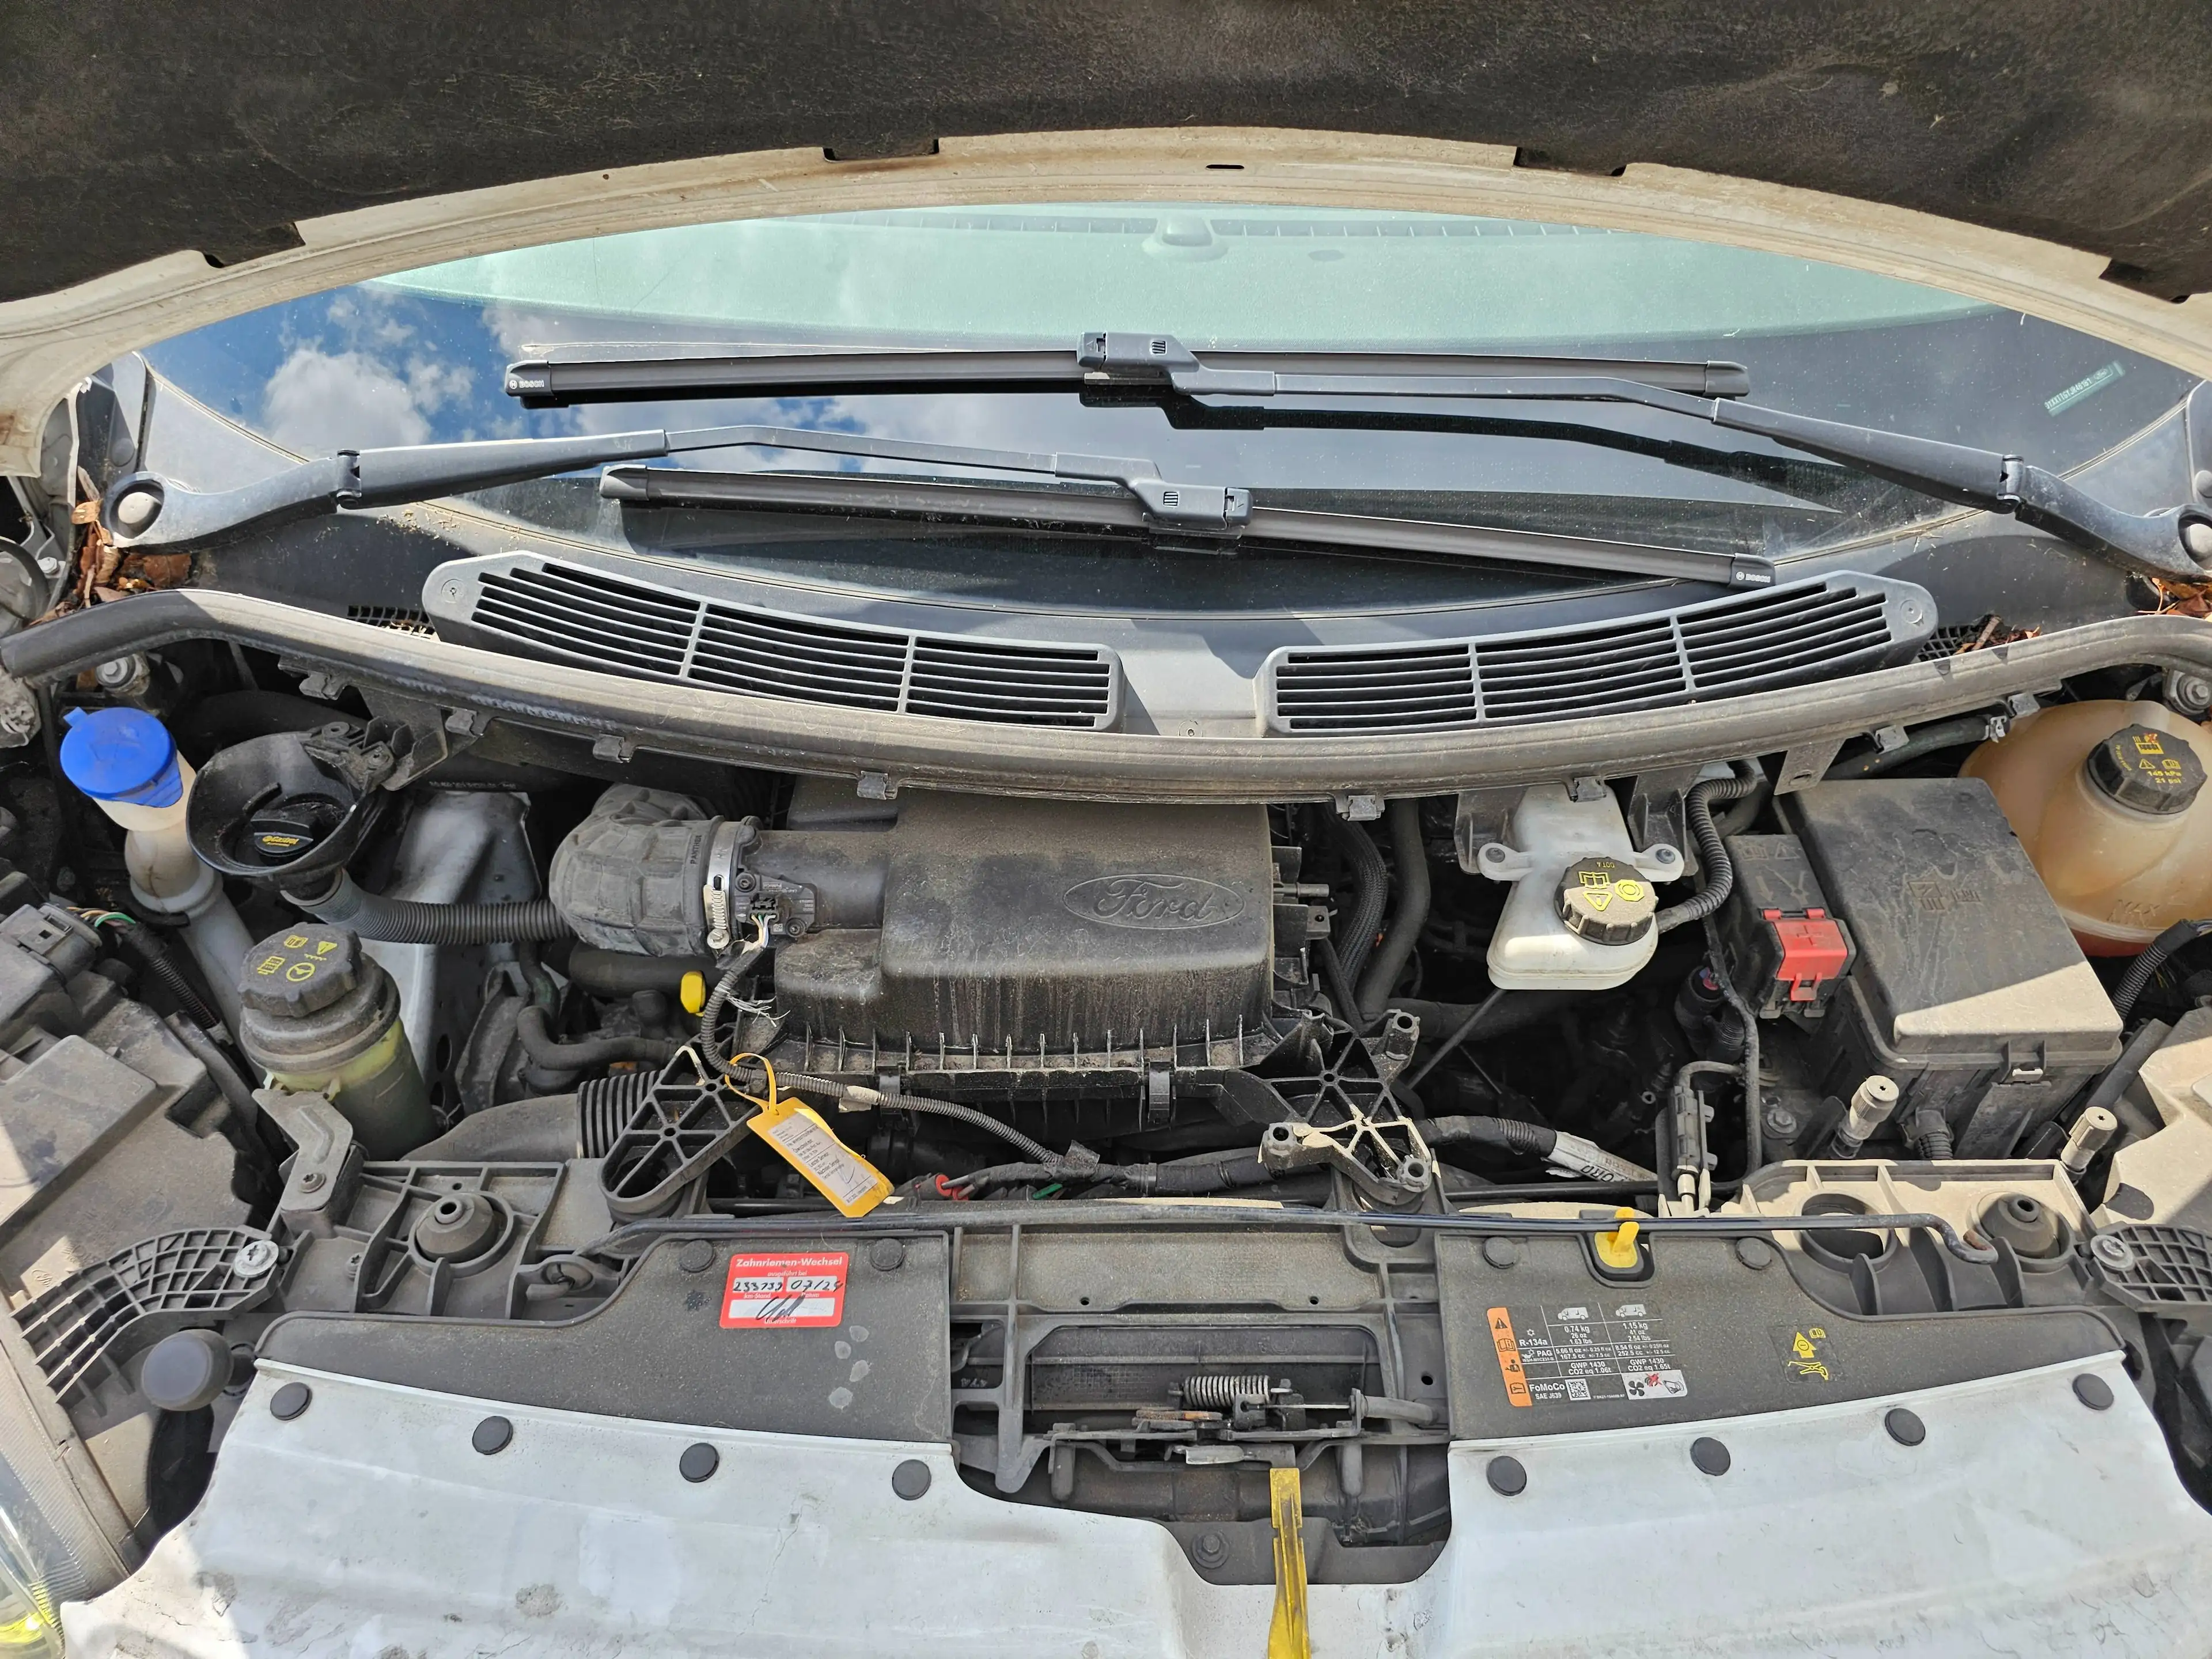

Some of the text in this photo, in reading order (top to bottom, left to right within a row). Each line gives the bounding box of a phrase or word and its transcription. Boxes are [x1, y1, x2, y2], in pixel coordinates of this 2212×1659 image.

[519, 380, 545, 388] BOSCH
[1092, 878, 1217, 922] Ford
[1581, 1165, 1625, 1182] ORD
[736, 1256, 843, 1267] Zahnriemen-Wechsel
[1580, 1325, 1590, 1333] kg
[1638, 1322, 1648, 1330] kg
[1519, 1339, 1548, 1347] R-134a
[1529, 1382, 1565, 1392] FoMoCo
